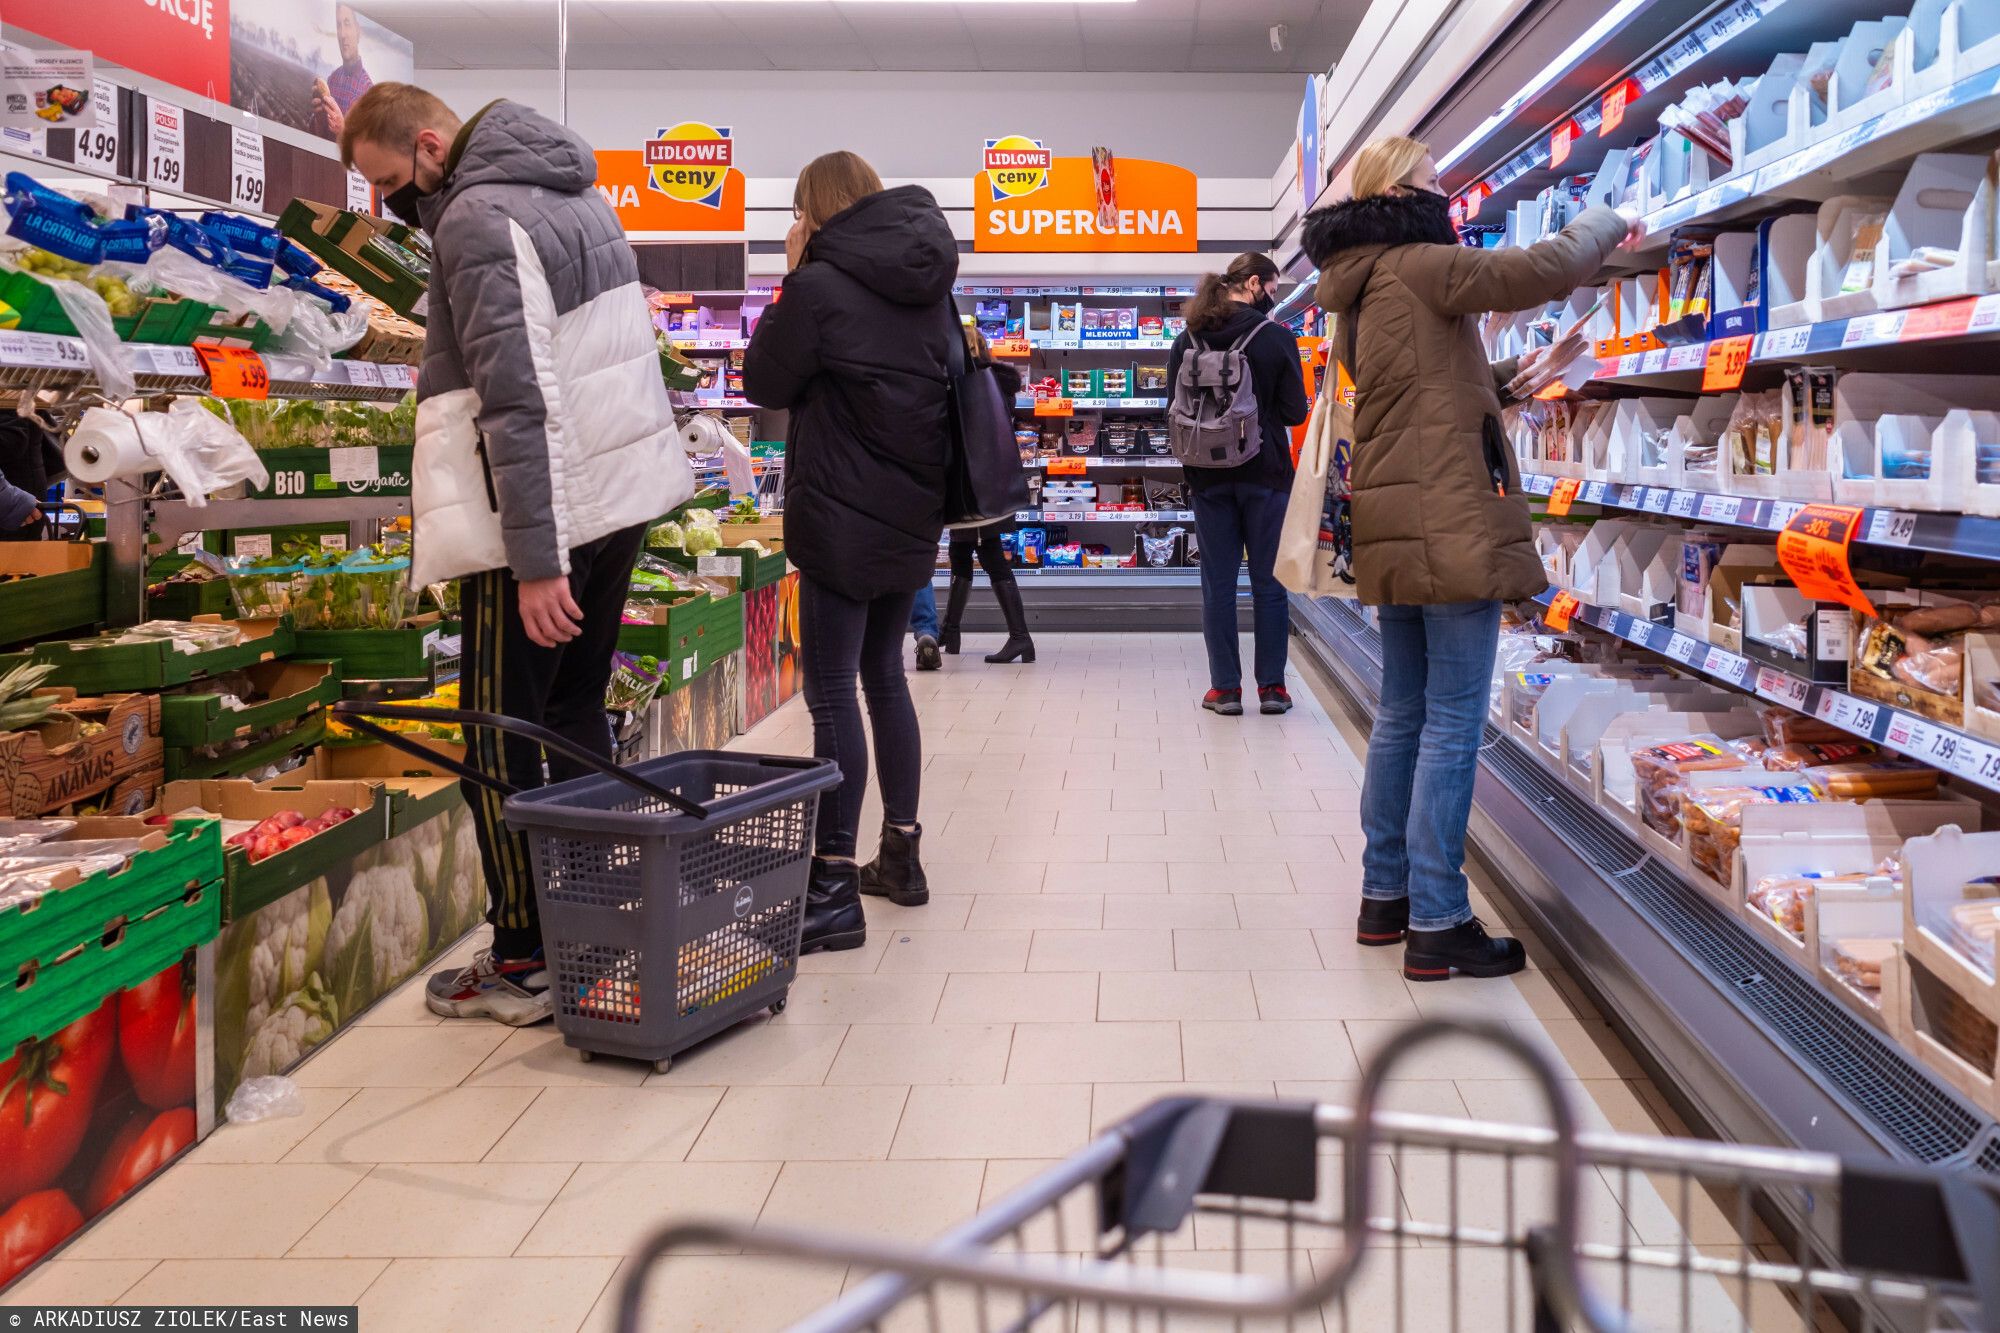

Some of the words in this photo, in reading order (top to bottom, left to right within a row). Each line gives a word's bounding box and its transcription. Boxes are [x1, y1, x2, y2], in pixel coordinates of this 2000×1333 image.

[155, 112, 177, 130] POLSKI
[78, 129, 116, 162] 4.99
[650, 144, 728, 160] LIDLOWE
[152, 155, 180, 183] 1.99
[988, 153, 1047, 165] LIDLOWE
[235, 173, 263, 204] 1.99
[662, 169, 716, 189] ceny
[997, 171, 1038, 185] ceny
[600, 184, 640, 208] NA
[25, 213, 41, 229] LA
[41, 219, 96, 249] CATALINA
[988, 209, 1184, 235] SUPERCENA
[1010, 343, 1029, 353] 5.99
[1890, 517, 1914, 539] 2.49
[1729, 659, 1747, 678] 7.99
[1852, 707, 1875, 731] 7.99
[1930, 733, 1957, 760] 7.99
[47, 751, 114, 802] ANANAS
